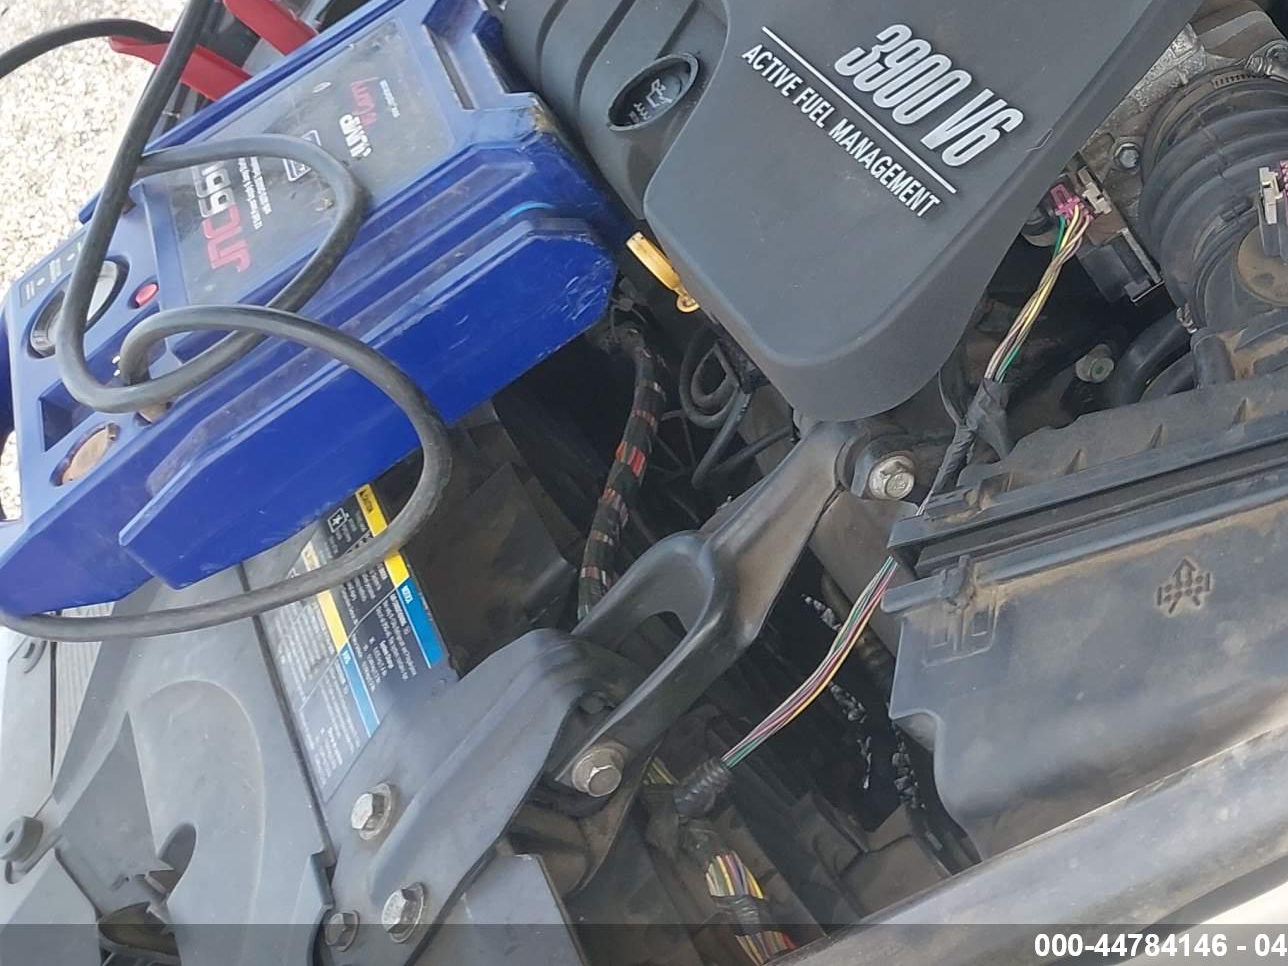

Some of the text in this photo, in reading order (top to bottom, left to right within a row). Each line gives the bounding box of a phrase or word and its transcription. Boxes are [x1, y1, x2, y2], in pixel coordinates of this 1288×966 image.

[339, 114, 372, 157] JUMP
[741, 44, 941, 217] ACTIVE FUEL MANAGEMENT
[833, 23, 1024, 167] 3900 V6
